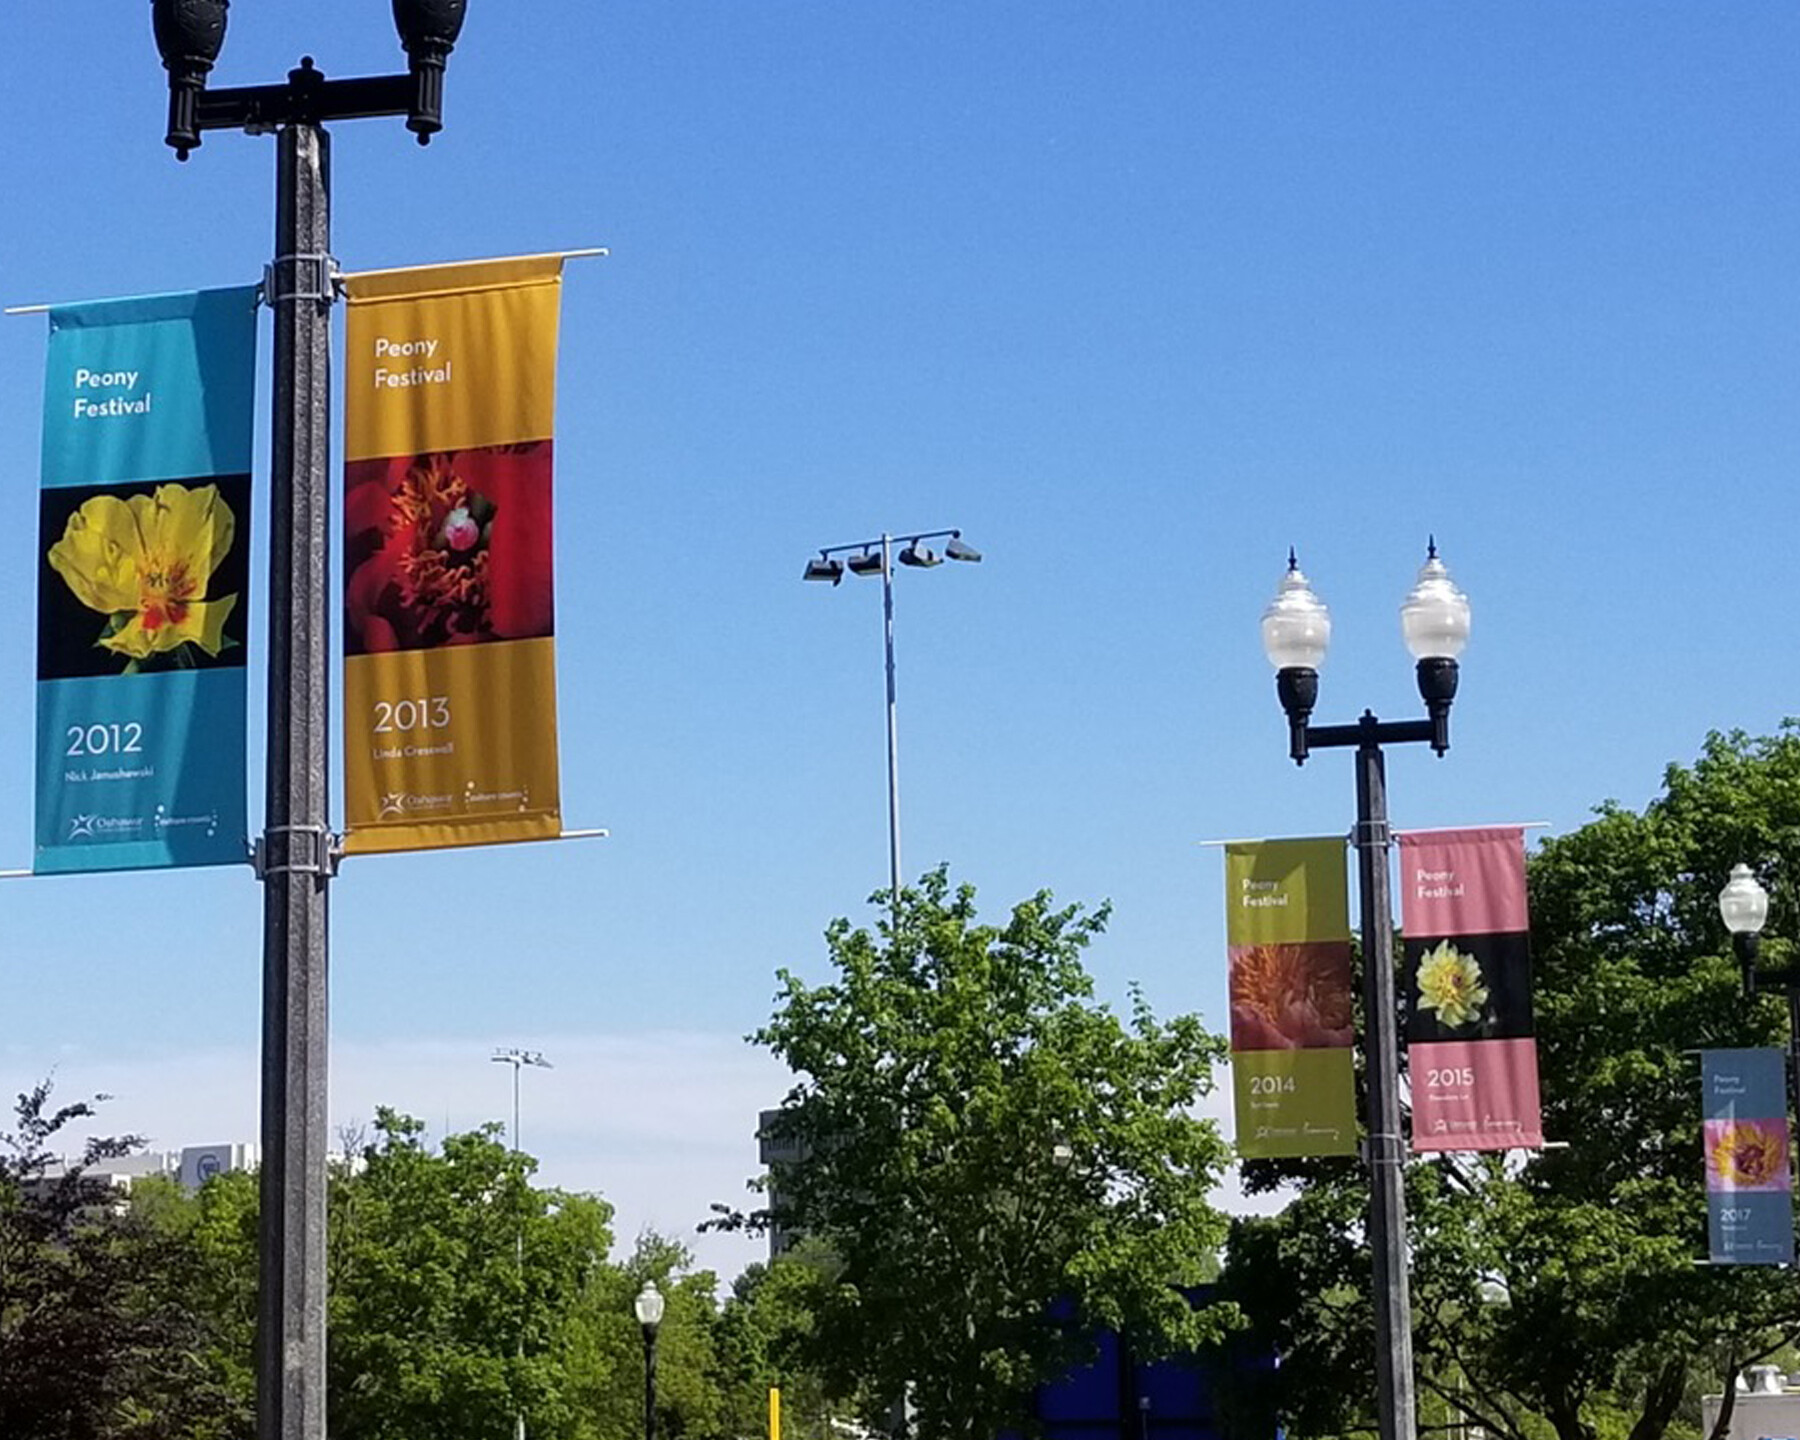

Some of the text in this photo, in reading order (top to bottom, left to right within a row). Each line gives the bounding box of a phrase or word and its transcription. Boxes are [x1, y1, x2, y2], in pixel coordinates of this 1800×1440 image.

[375, 337, 438, 358] Peony
[75, 368, 138, 390] Peony
[375, 361, 451, 388] Festival
[74, 392, 151, 419] Festival
[373, 697, 450, 732] 2013
[66, 722, 142, 756] 2012
[1242, 893, 1288, 907] Festival
[1417, 883, 1465, 899] Festival
[1250, 1076, 1296, 1095] 2014
[1427, 1067, 1474, 1087] 2015
[1720, 1208, 1752, 1222] 2017
